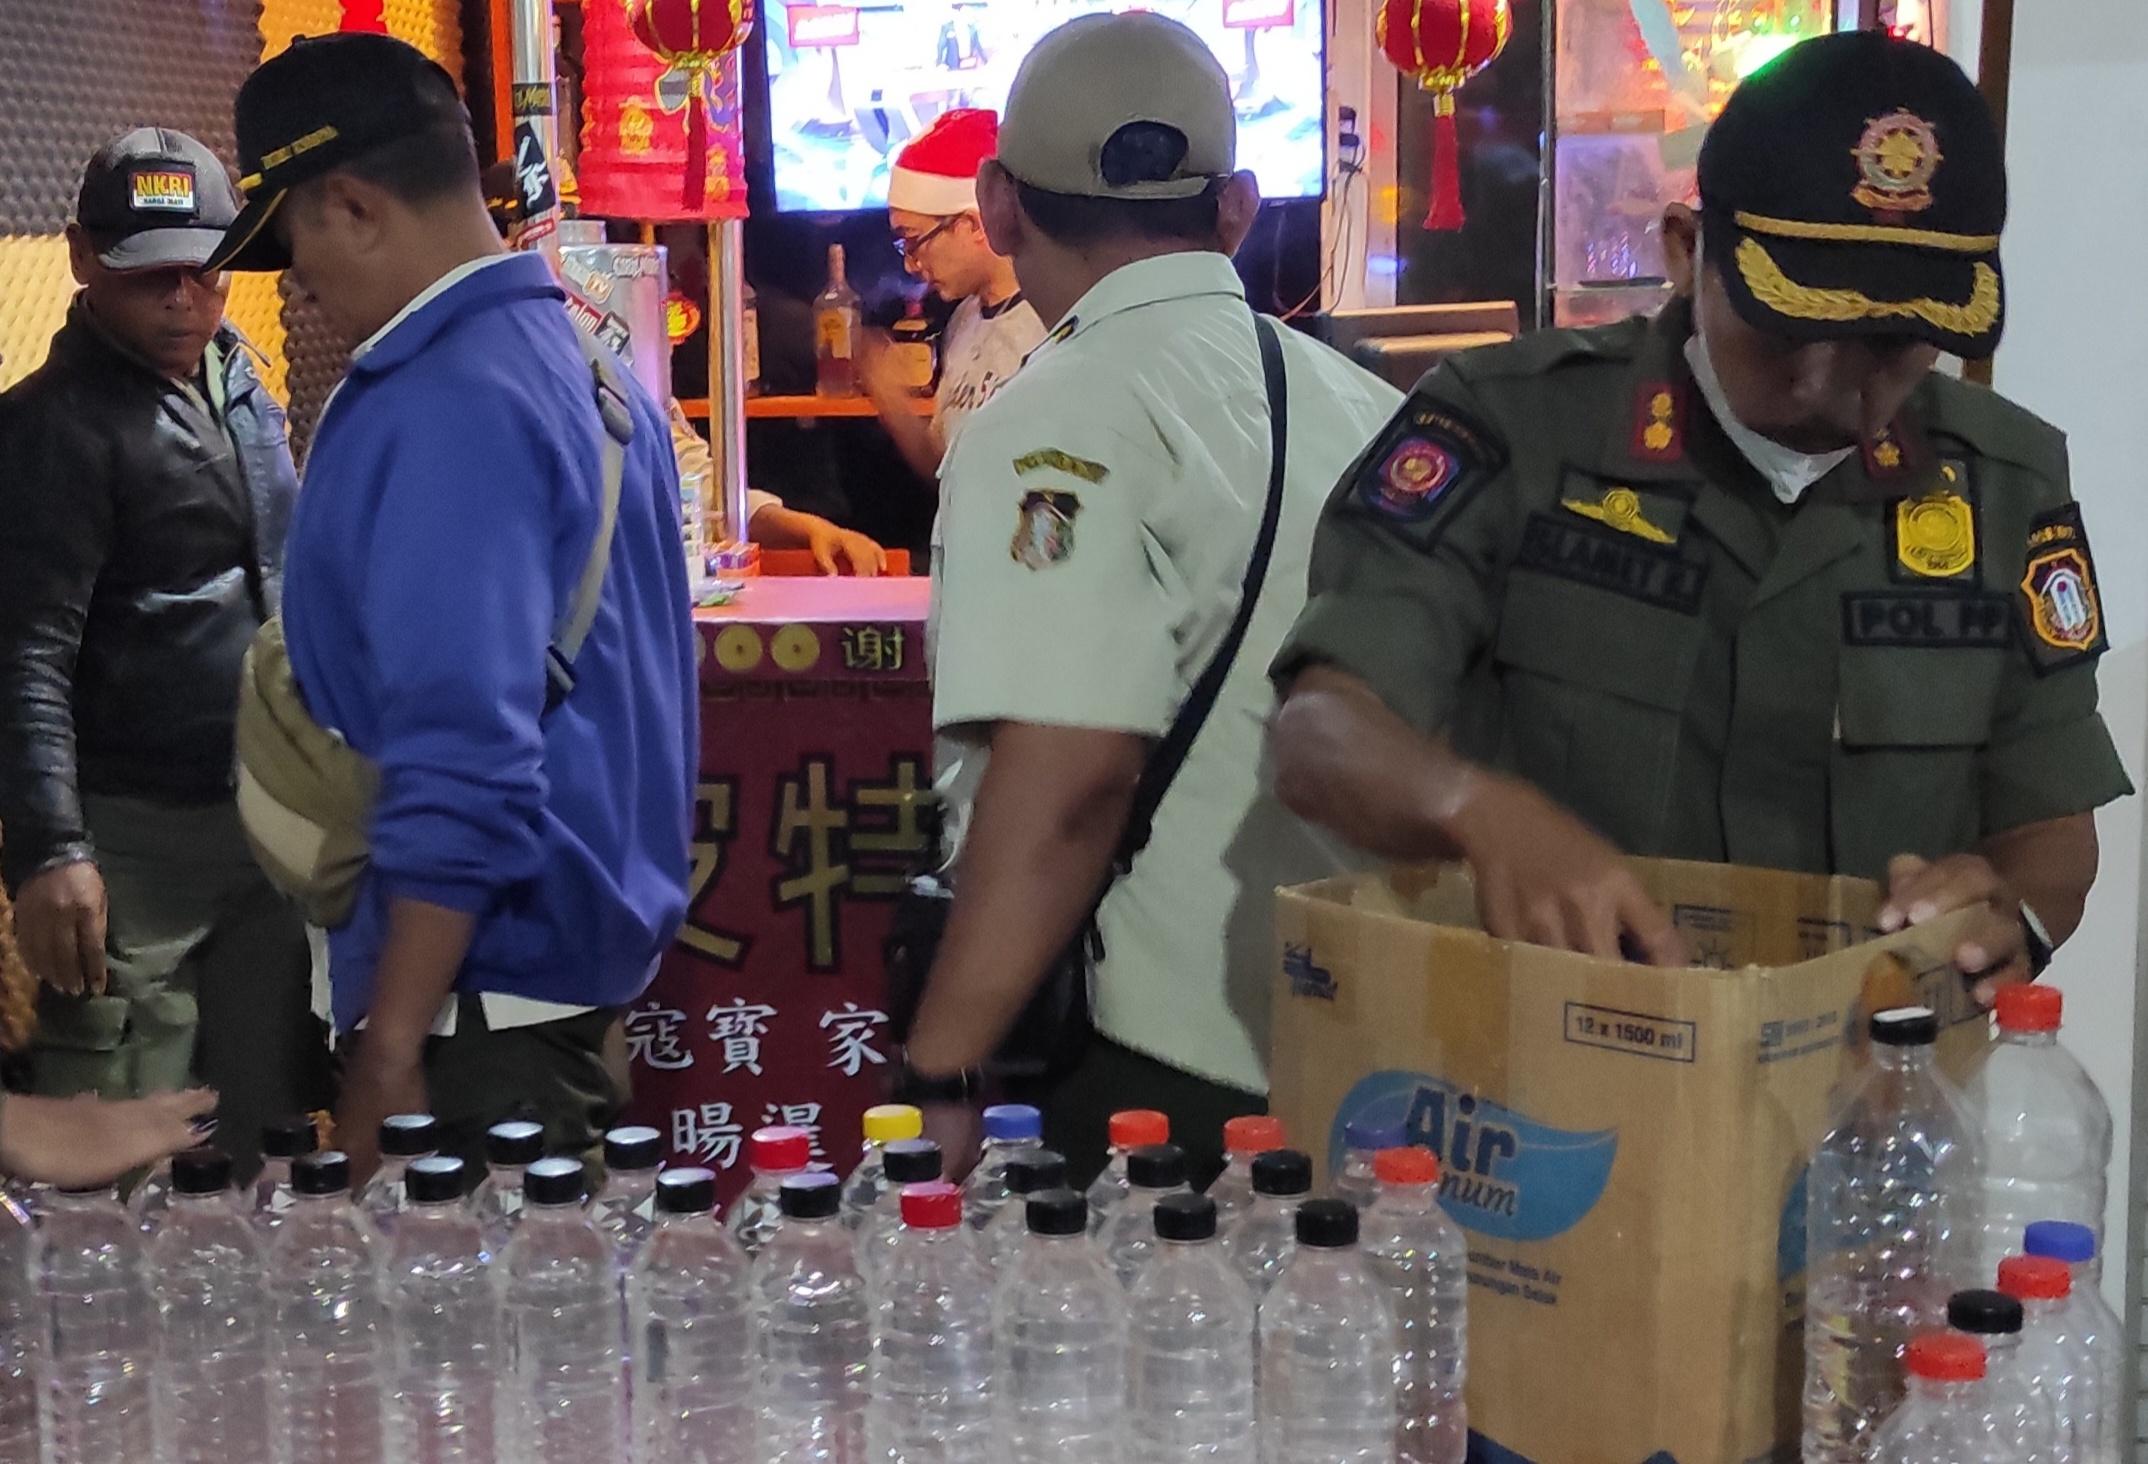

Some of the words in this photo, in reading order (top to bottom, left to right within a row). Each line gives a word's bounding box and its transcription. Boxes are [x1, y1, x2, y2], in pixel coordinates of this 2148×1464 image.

[136, 174, 190, 197] NKRI
[1861, 600, 1944, 637] POL
[1576, 1015, 1594, 1034] 12
[1600, 1022, 1609, 1037] x
[1615, 1021, 1655, 1046] 1500
[1660, 1031, 1683, 1049] ml
[1404, 1085, 1517, 1176] Air
[1439, 1170, 1517, 1217] num
